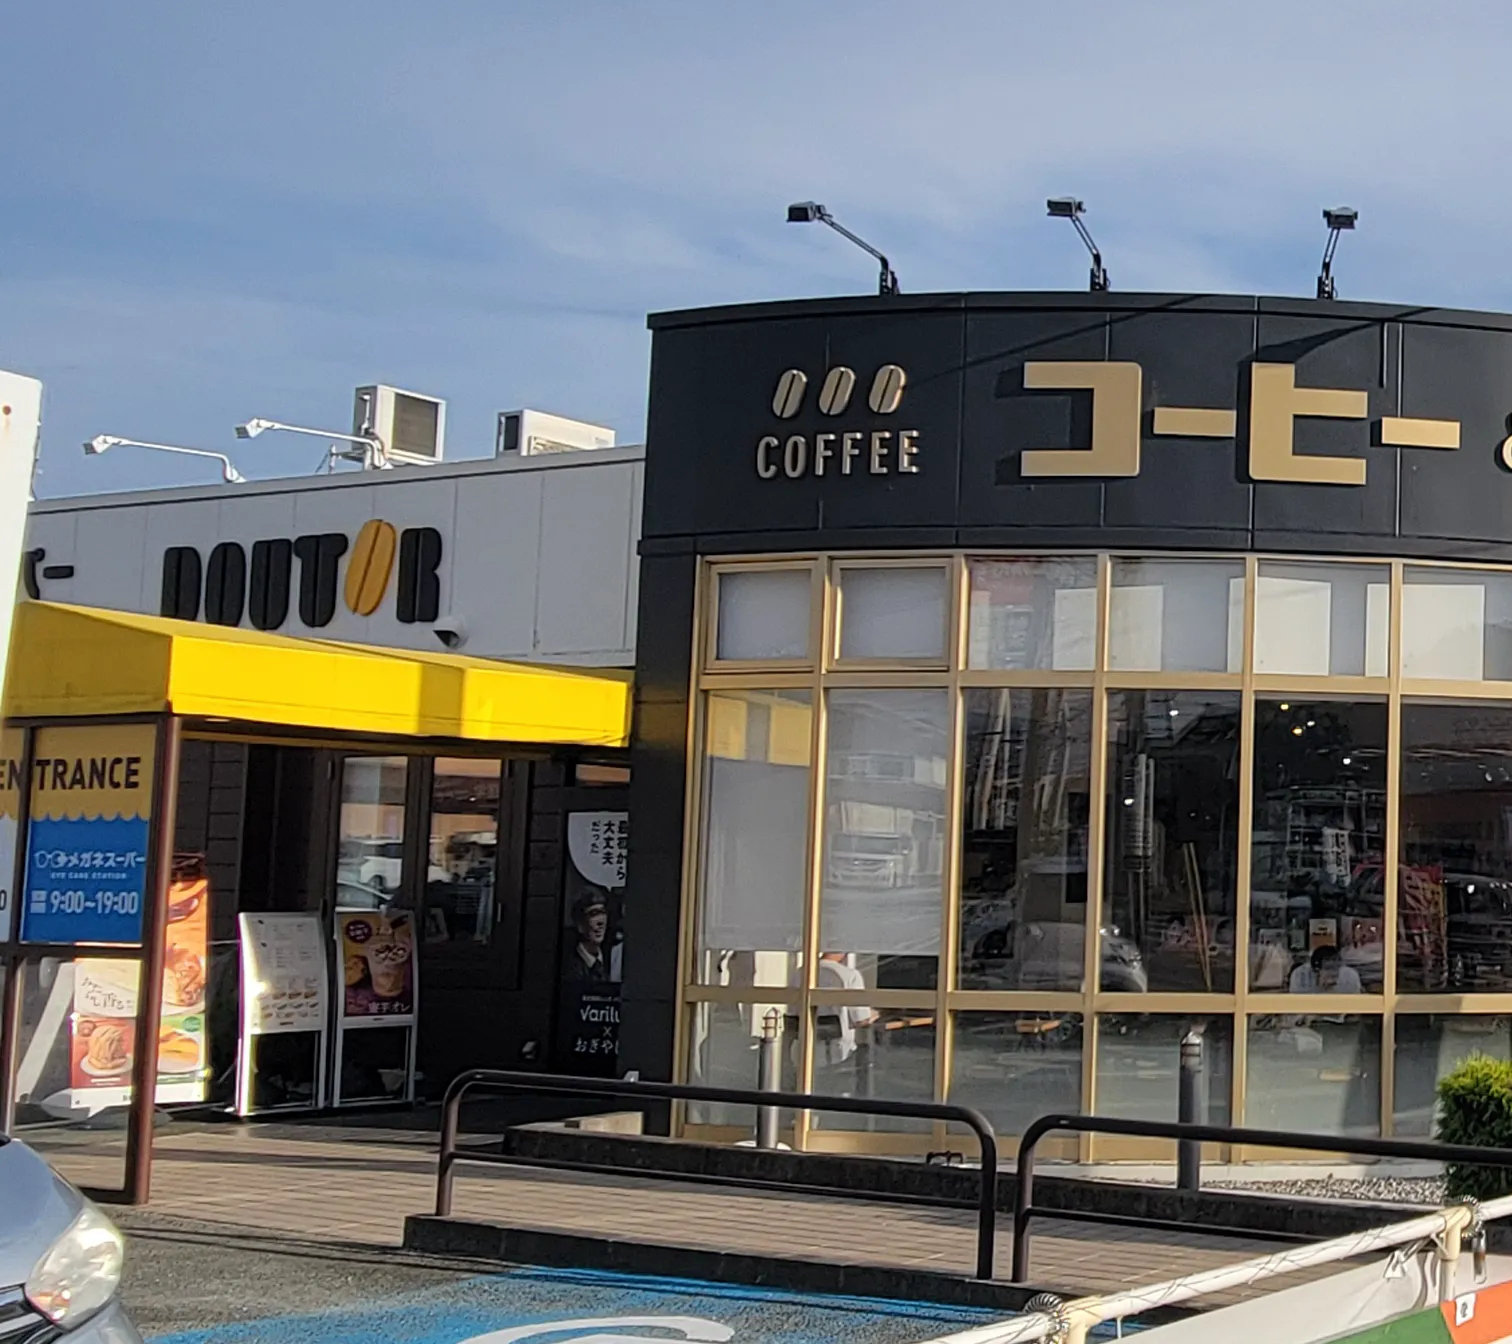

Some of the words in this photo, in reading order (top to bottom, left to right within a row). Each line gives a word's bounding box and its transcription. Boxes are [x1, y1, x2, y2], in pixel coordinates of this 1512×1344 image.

[1020, 361, 1461, 486] コーヒー
[756, 429, 920, 481] COFFEE
[160, 518, 443, 631] DOUTOR
[0, 757, 141, 790] NTRANCE
[67, 850, 147, 868] メガネスーパー
[602, 820, 615, 865] 大丈夫
